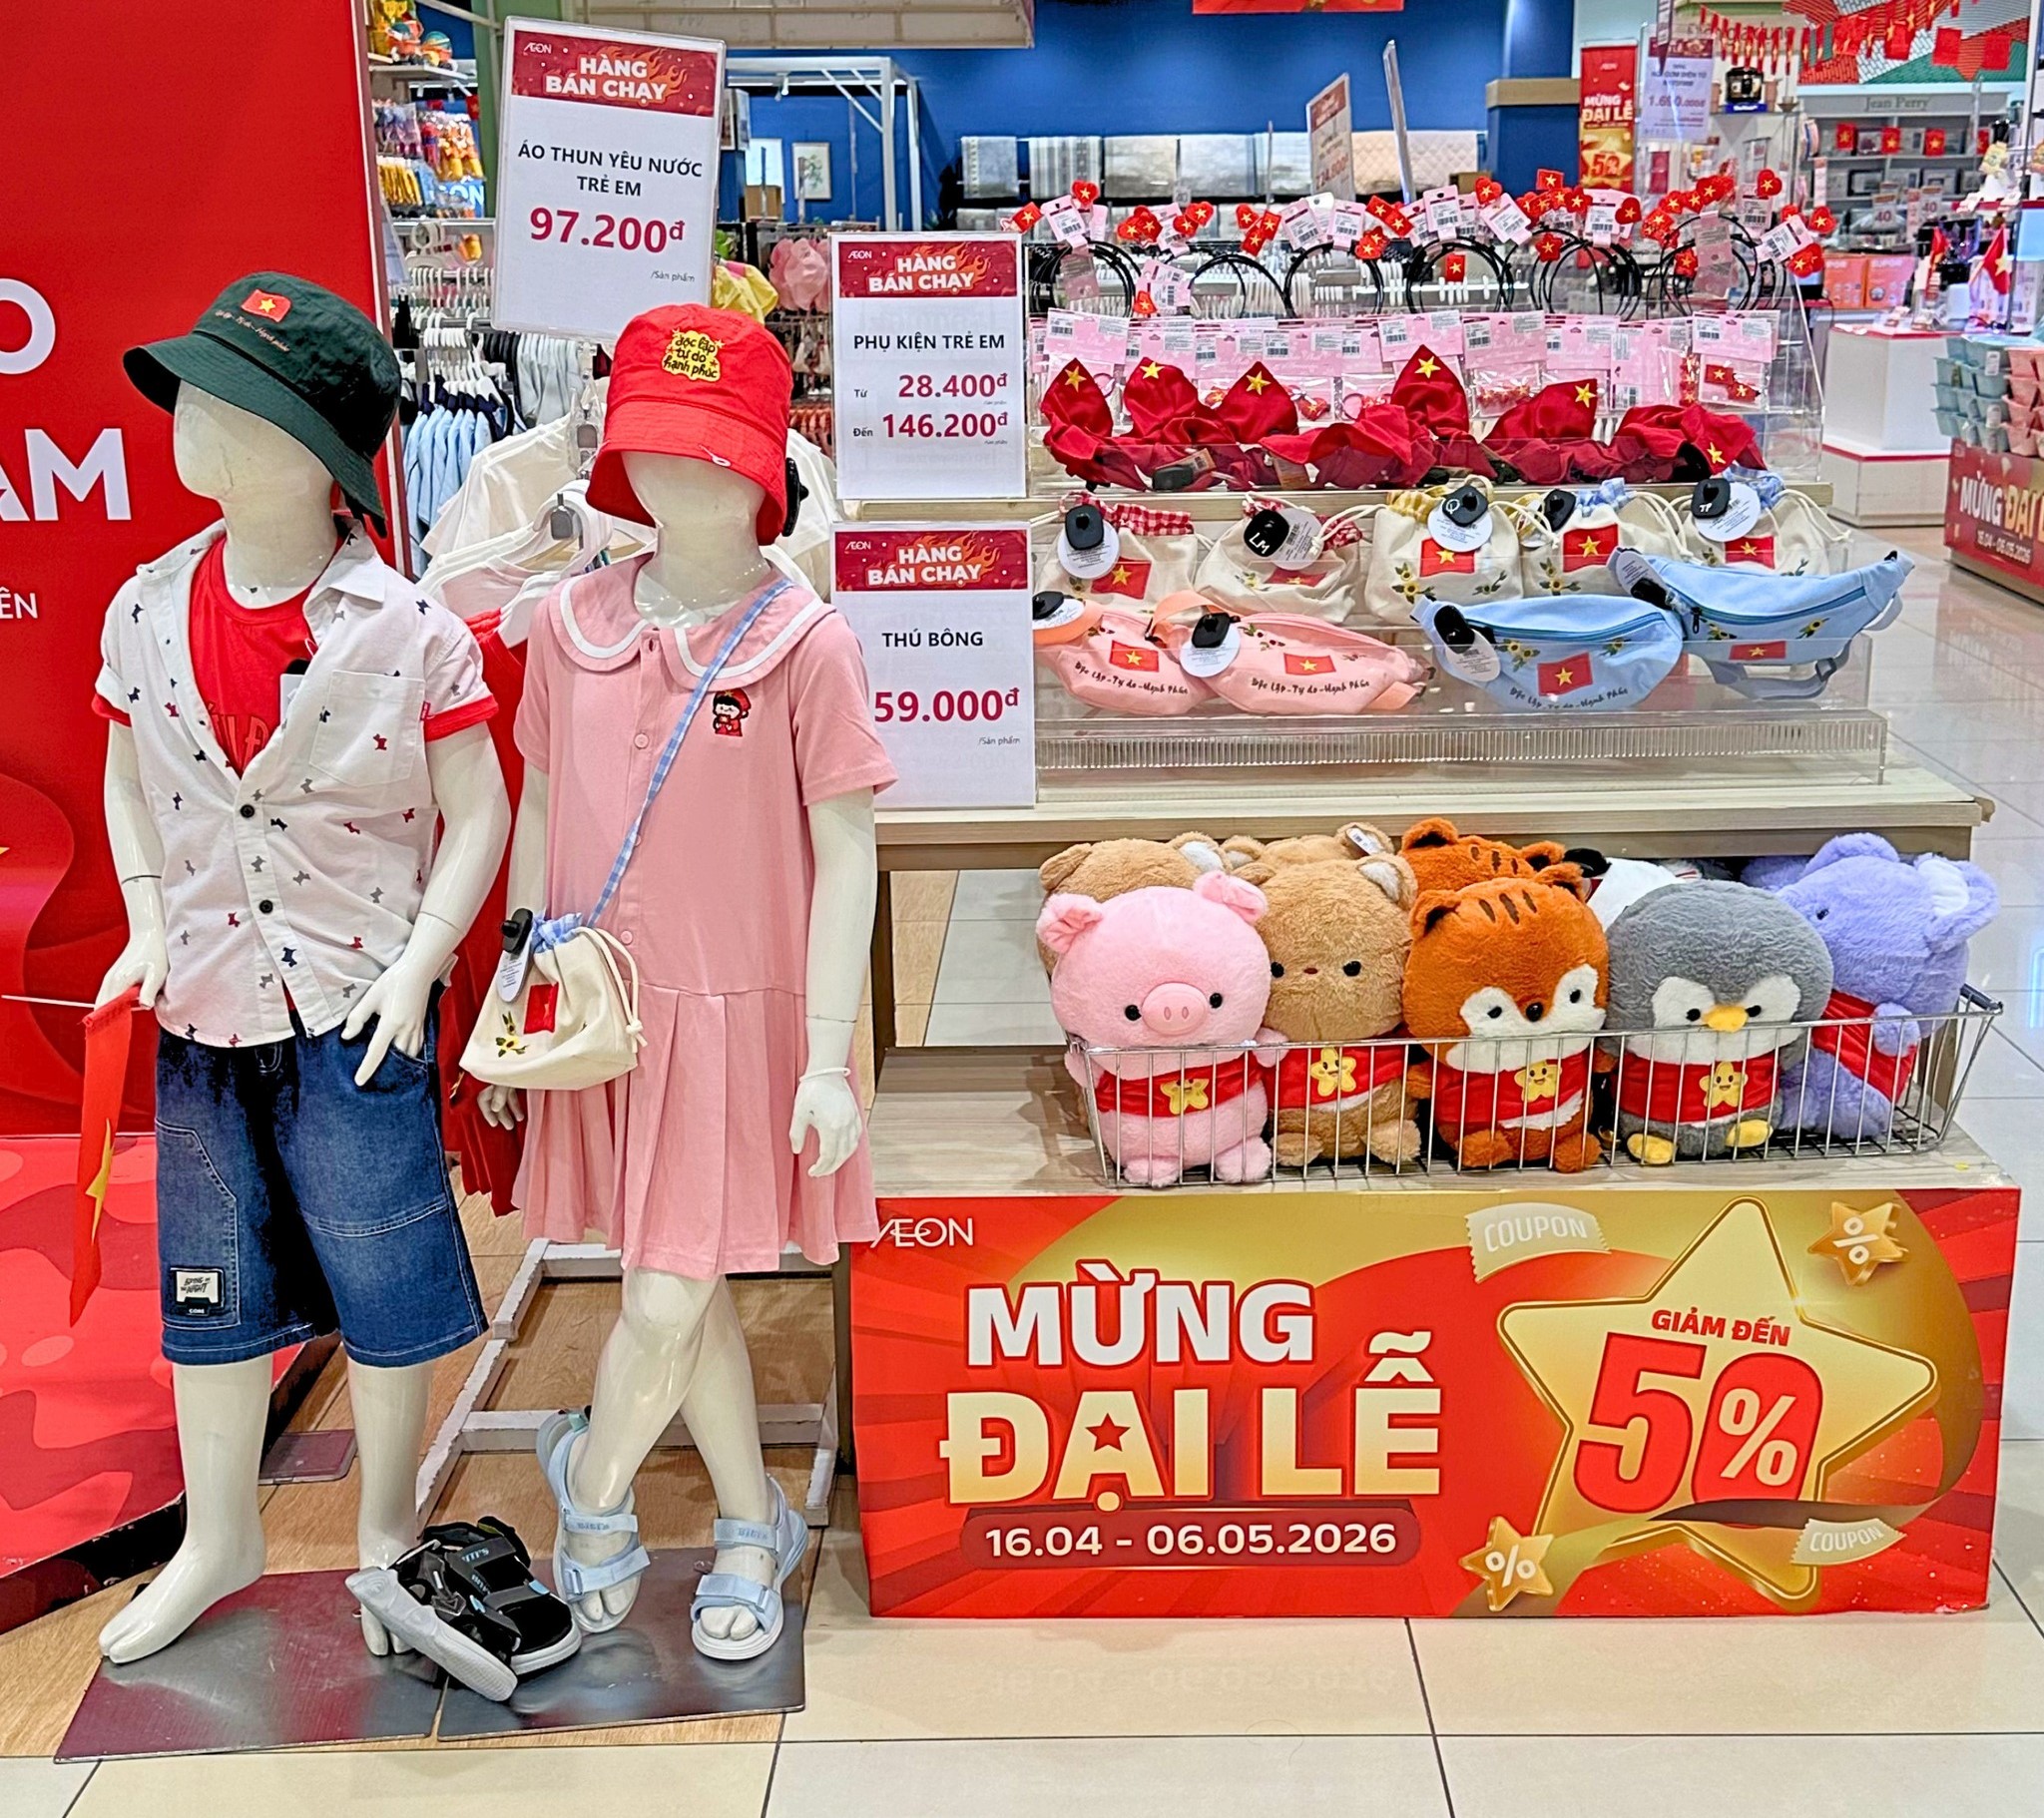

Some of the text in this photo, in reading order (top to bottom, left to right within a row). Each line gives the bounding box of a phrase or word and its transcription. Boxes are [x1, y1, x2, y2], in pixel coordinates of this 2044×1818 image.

[580, 54, 647, 78] HÀNG
[546, 73, 667, 104] BÁN CHẠY
[1863, 96, 1931, 112] Jean Perry
[518, 140, 703, 177] ÁO THUN YÊU NƯỚC
[577, 174, 642, 197] TRẺ EM
[530, 207, 686, 253] 97.200đ
[897, 253, 956, 272] HÀNG
[868, 272, 974, 292] BÁN CHẠY
[854, 330, 1005, 352] PHỤ KIỆN TRẺ EM
[898, 372, 1008, 398] 28.400đ
[852, 412, 1008, 438] Đến 146.200đ
[1959, 470, 2003, 527] MỪNG
[898, 544, 962, 565] HÀNG
[867, 564, 982, 586] BÁN CHẠY
[881, 628, 983, 648] THÚ BÔNG
[873, 686, 1020, 722] 59.000đ
[1483, 1214, 1589, 1253] COUPON
[967, 1261, 1314, 1366] MỪNG
[1651, 1307, 1791, 1347] GIẢM ĐẾN
[938, 1330, 1442, 1512] ĐẠI LỄ
[985, 1523, 1397, 1558] 16.04 - 06.05.2026
[1808, 1523, 1885, 1554] COUPON
